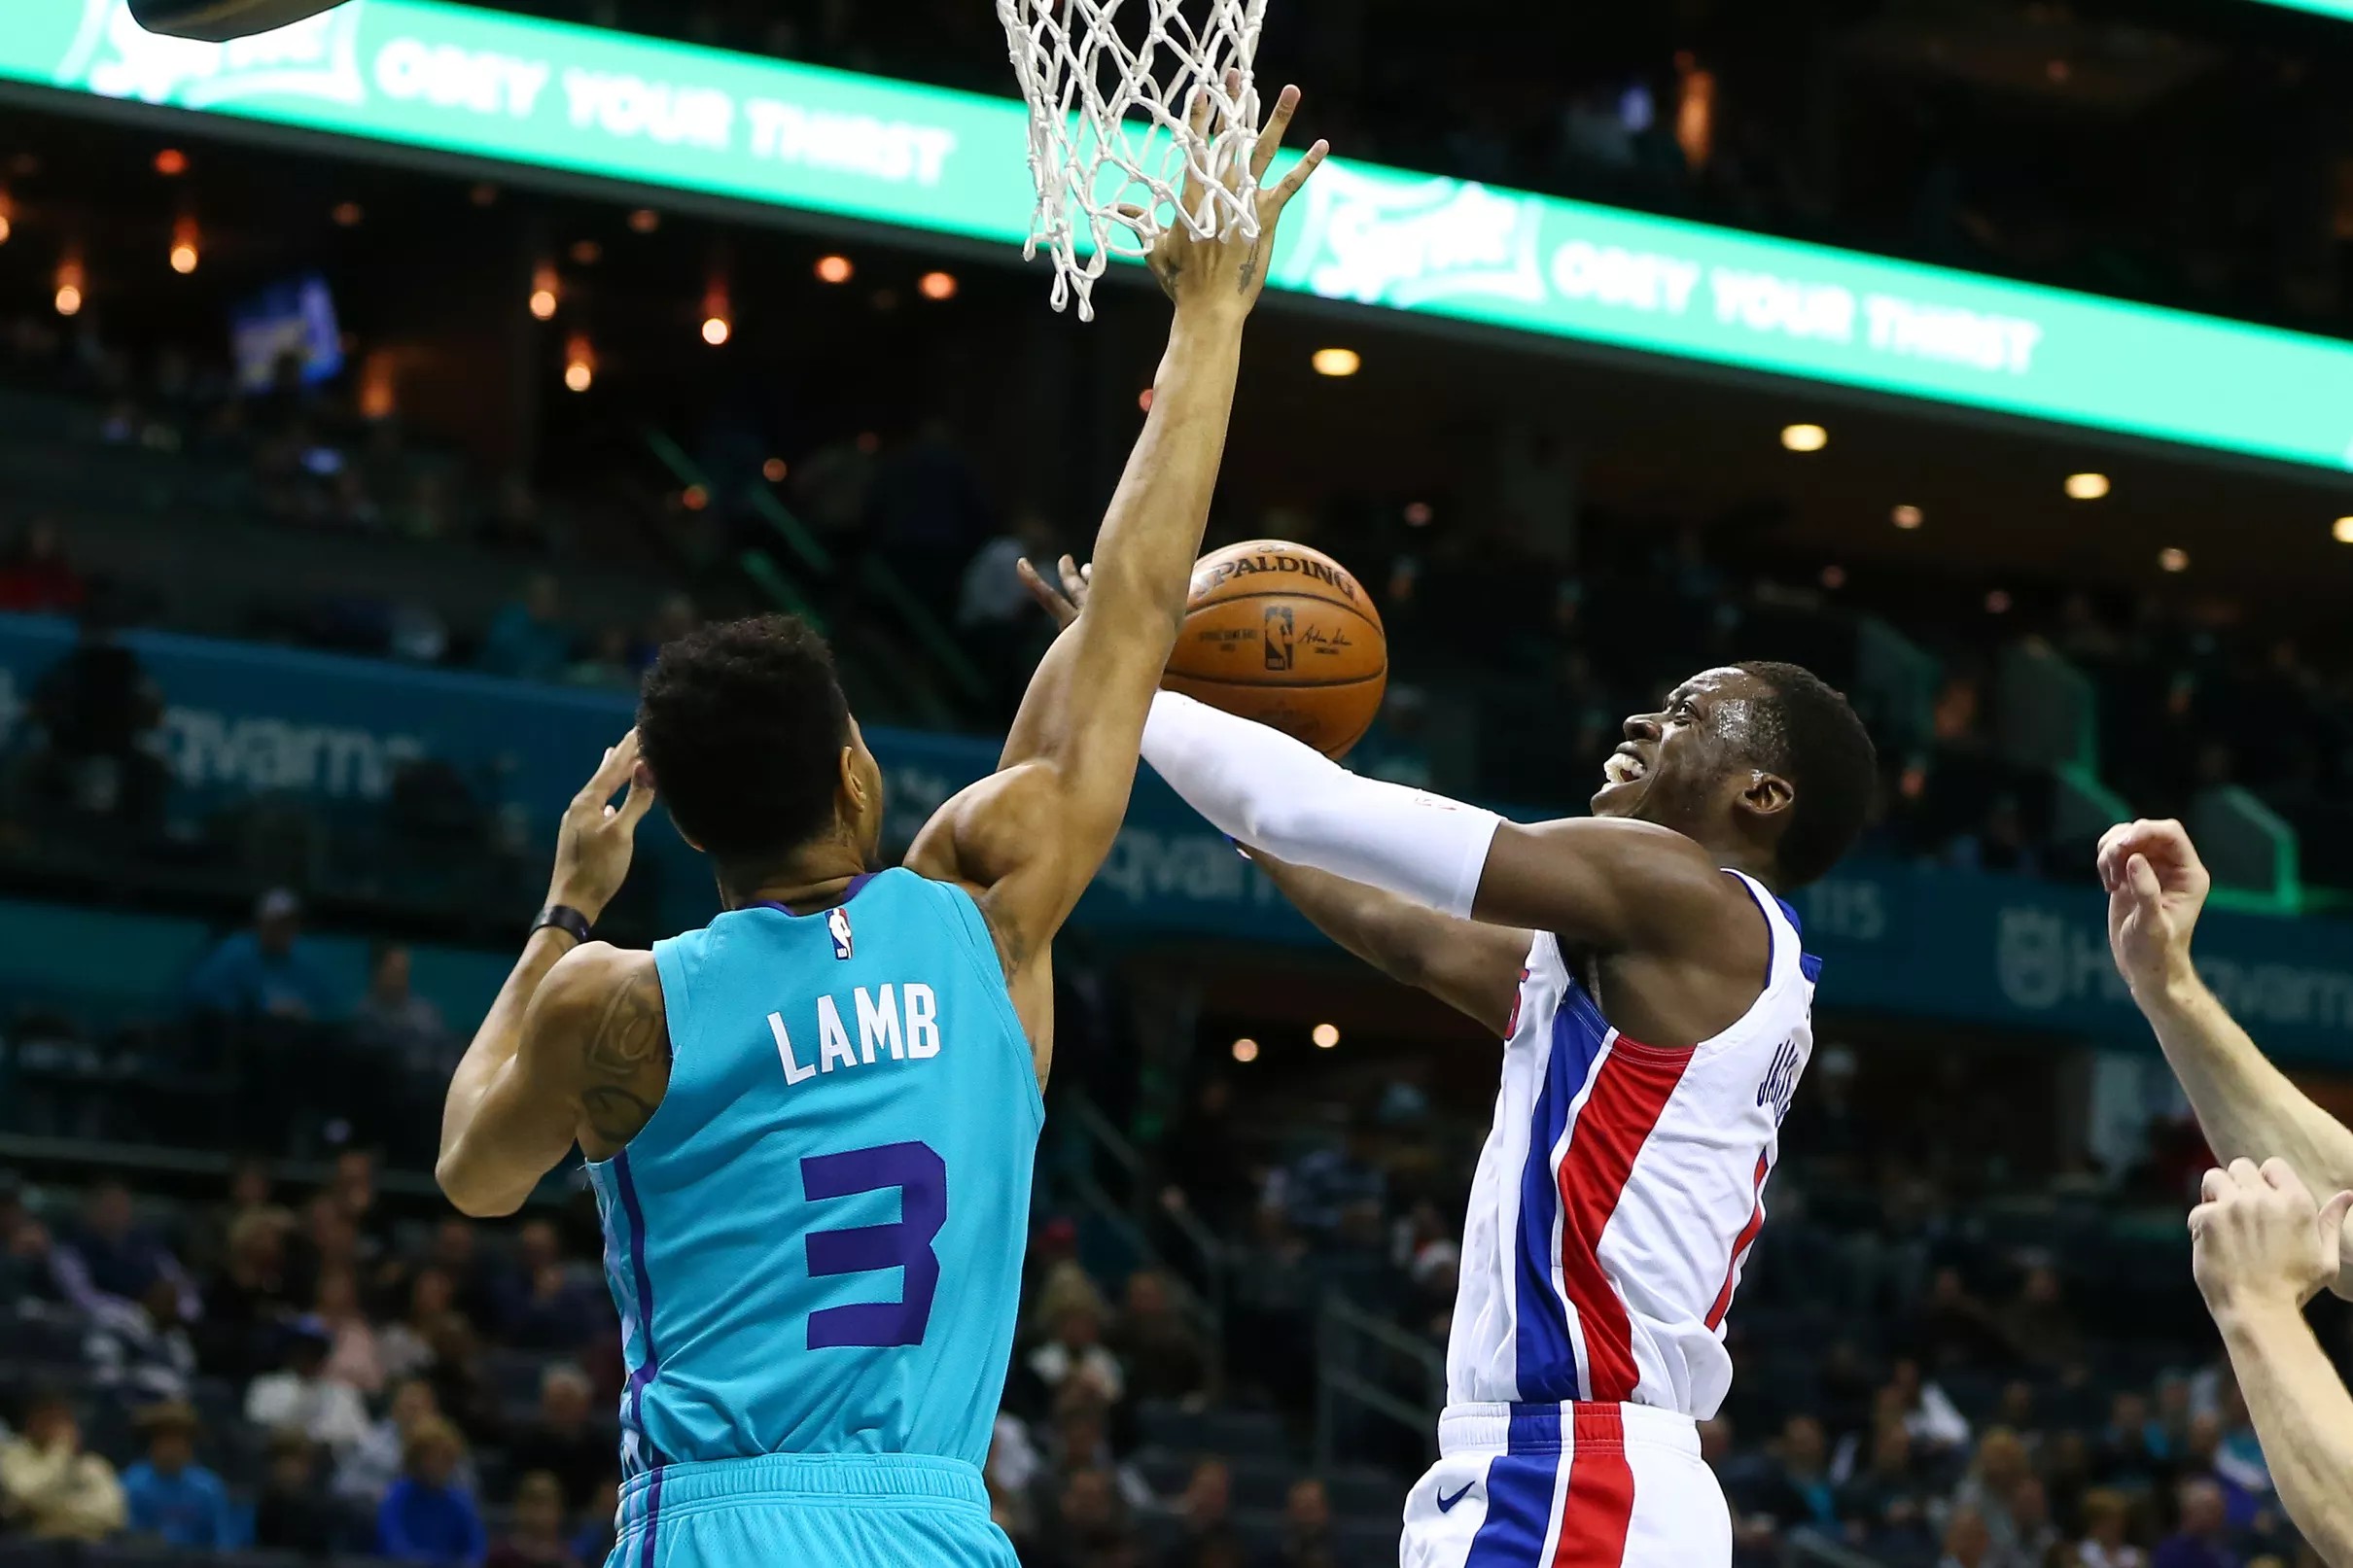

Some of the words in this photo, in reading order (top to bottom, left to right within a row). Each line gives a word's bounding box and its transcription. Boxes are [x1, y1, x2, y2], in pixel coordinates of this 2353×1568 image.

[374, 37, 548, 119] OBEY
[561, 66, 733, 153] YOUR
[745, 97, 956, 187] THIRST
[1551, 239, 1701, 314] OBEY
[1710, 266, 1855, 343] YOUR
[1863, 293, 2044, 376] THIRST
[766, 982, 942, 1086] LAMB
[799, 1139, 949, 1351] 3
